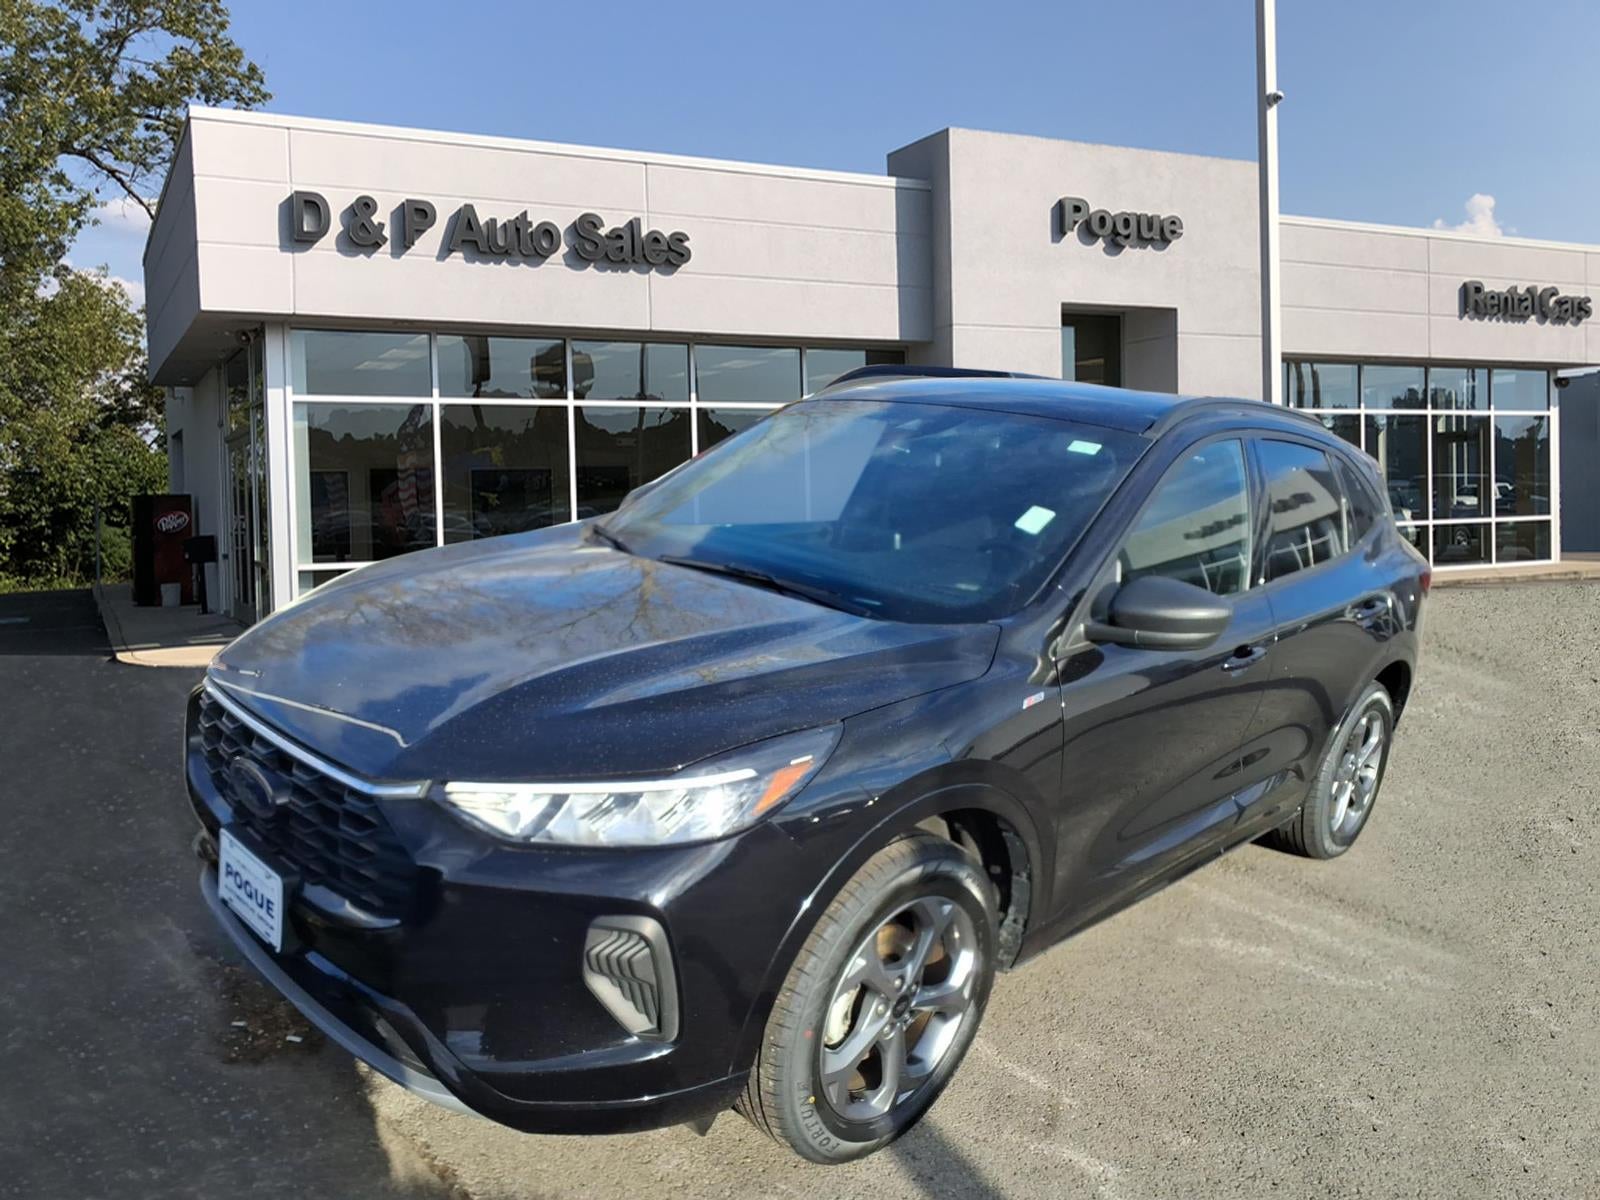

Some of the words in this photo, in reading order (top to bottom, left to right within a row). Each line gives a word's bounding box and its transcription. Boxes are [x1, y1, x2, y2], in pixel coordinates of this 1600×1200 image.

[292, 189, 331, 243] D
[349, 194, 388, 249] &
[403, 198, 437, 248] P
[449, 202, 562, 258] Auto
[574, 211, 692, 266] Sales
[1060, 196, 1184, 247] Pogue
[1463, 280, 1538, 318] Rental
[1539, 285, 1593, 321] Cars
[225, 861, 275, 919] POGUE
